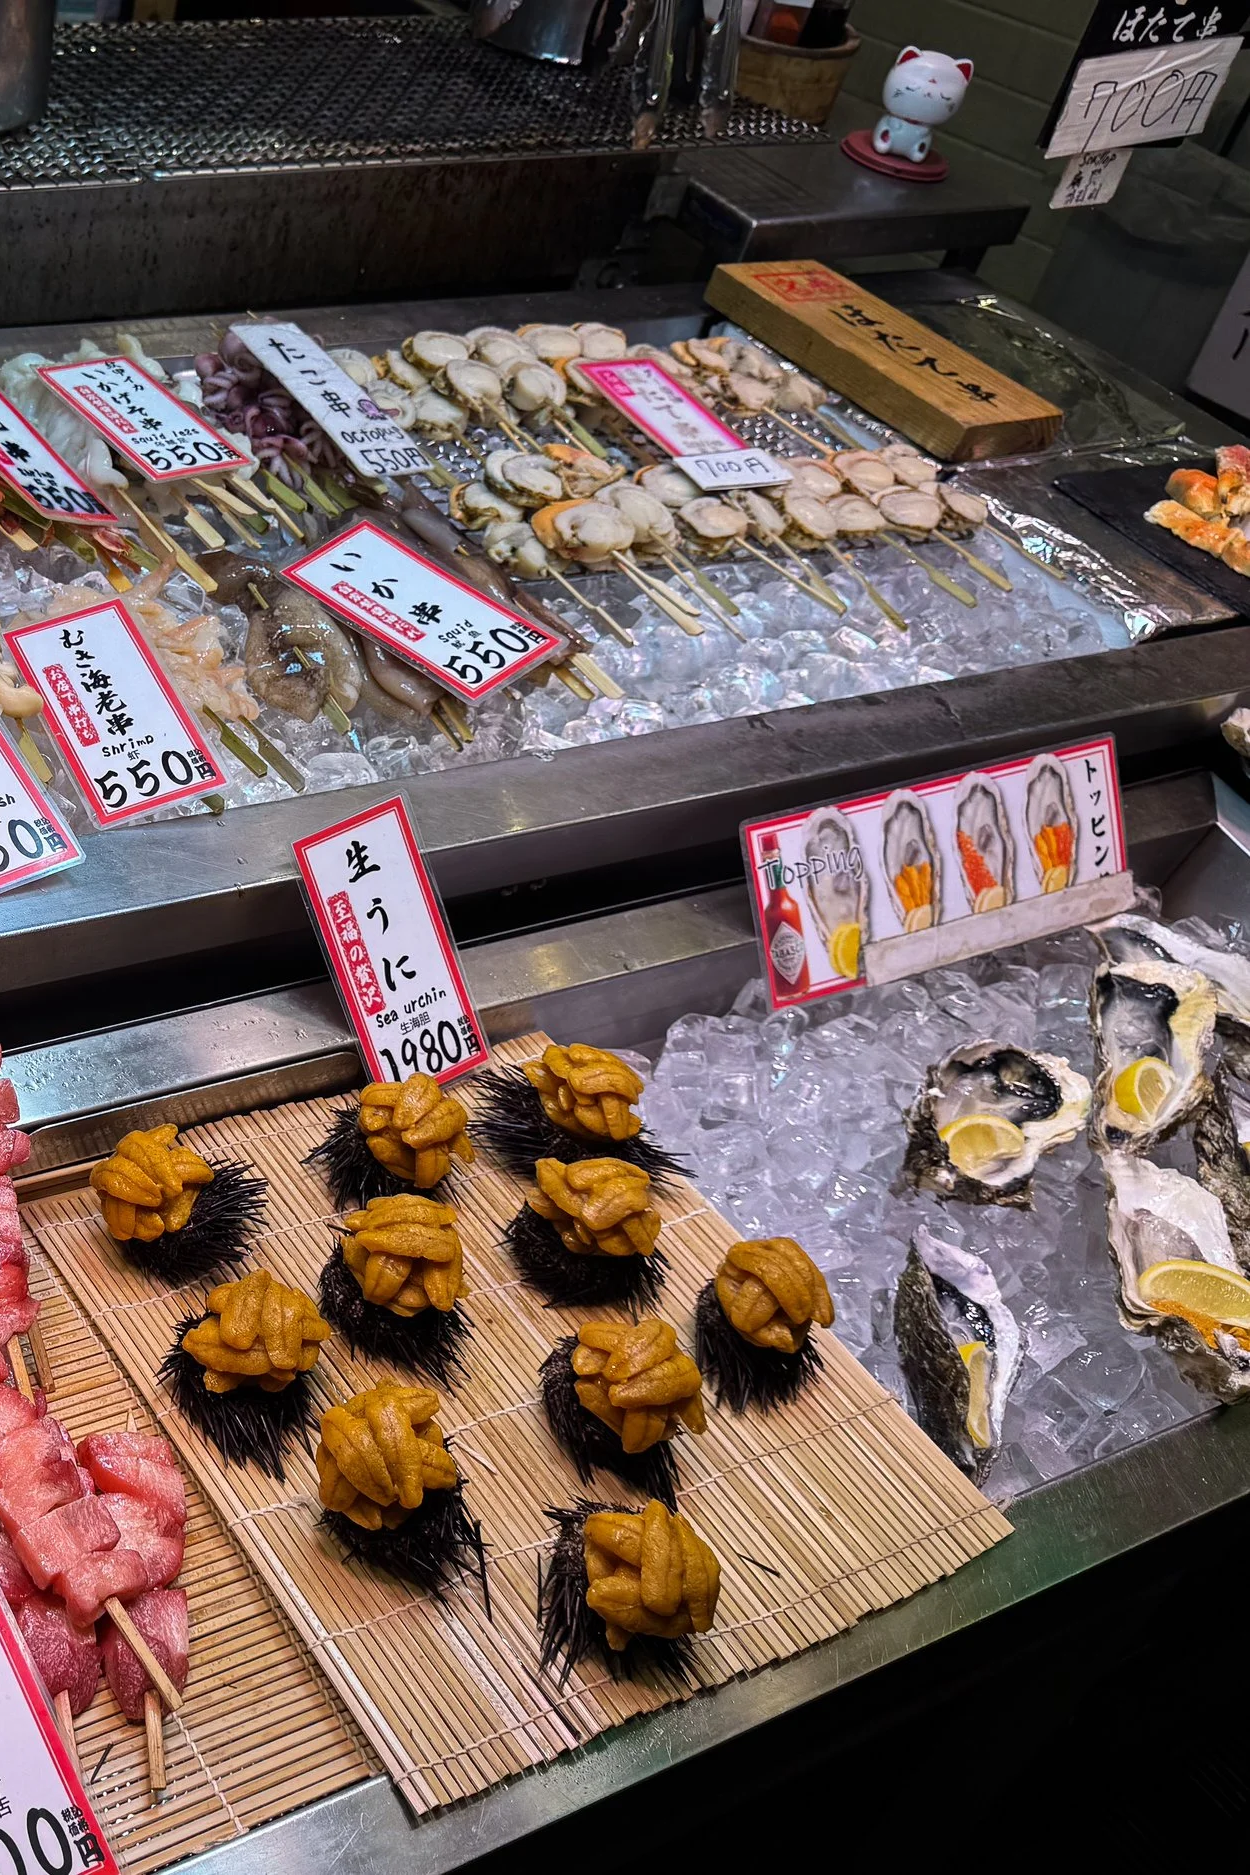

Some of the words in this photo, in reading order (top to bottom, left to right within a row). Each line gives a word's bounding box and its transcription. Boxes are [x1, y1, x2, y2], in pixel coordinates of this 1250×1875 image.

[1112, 6, 1223, 43] ほたて串
[268, 338, 350, 418] たこ串
[360, 448, 430, 474] 550円
[329, 552, 443, 625] いか串
[59, 629, 134, 736] むき海老串
[102, 734, 154, 757] Shrimp
[1085, 758, 1111, 880] トッピン
[756, 843, 865, 891] Topping
[345, 840, 417, 992] 生うに
[404, 987, 447, 1015] urchin
